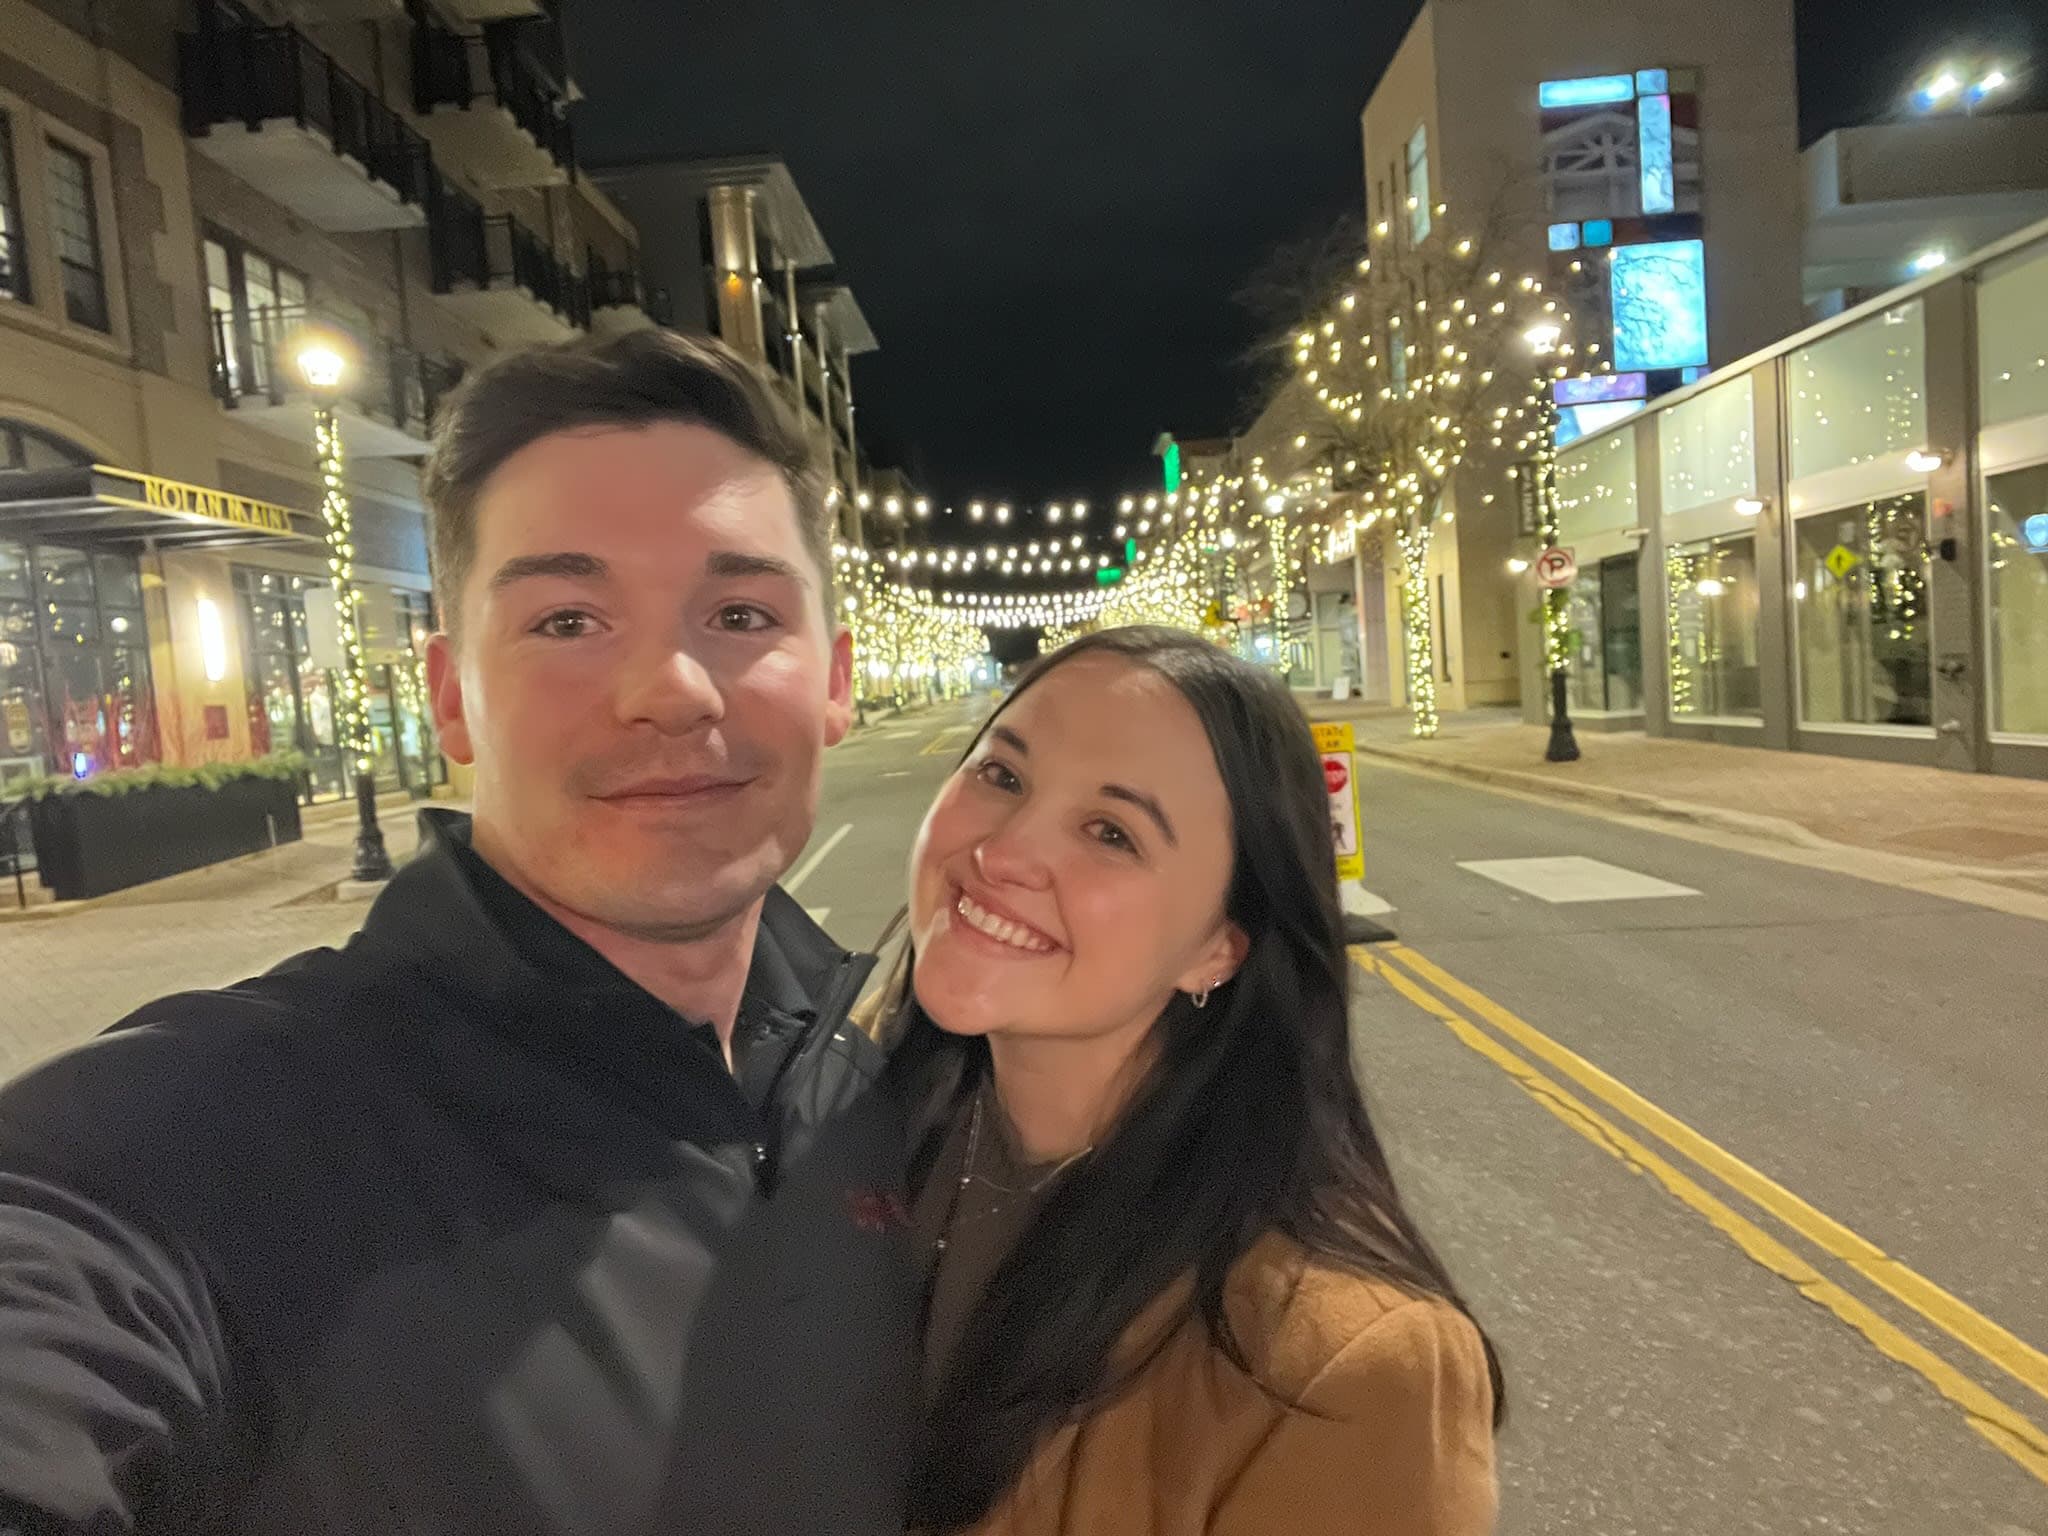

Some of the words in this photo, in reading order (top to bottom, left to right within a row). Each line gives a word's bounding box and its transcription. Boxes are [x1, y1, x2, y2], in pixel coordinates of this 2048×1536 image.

[145, 479, 223, 519] NOLAN
[227, 494, 293, 531] MAINS
[1550, 557, 1566, 577] P
